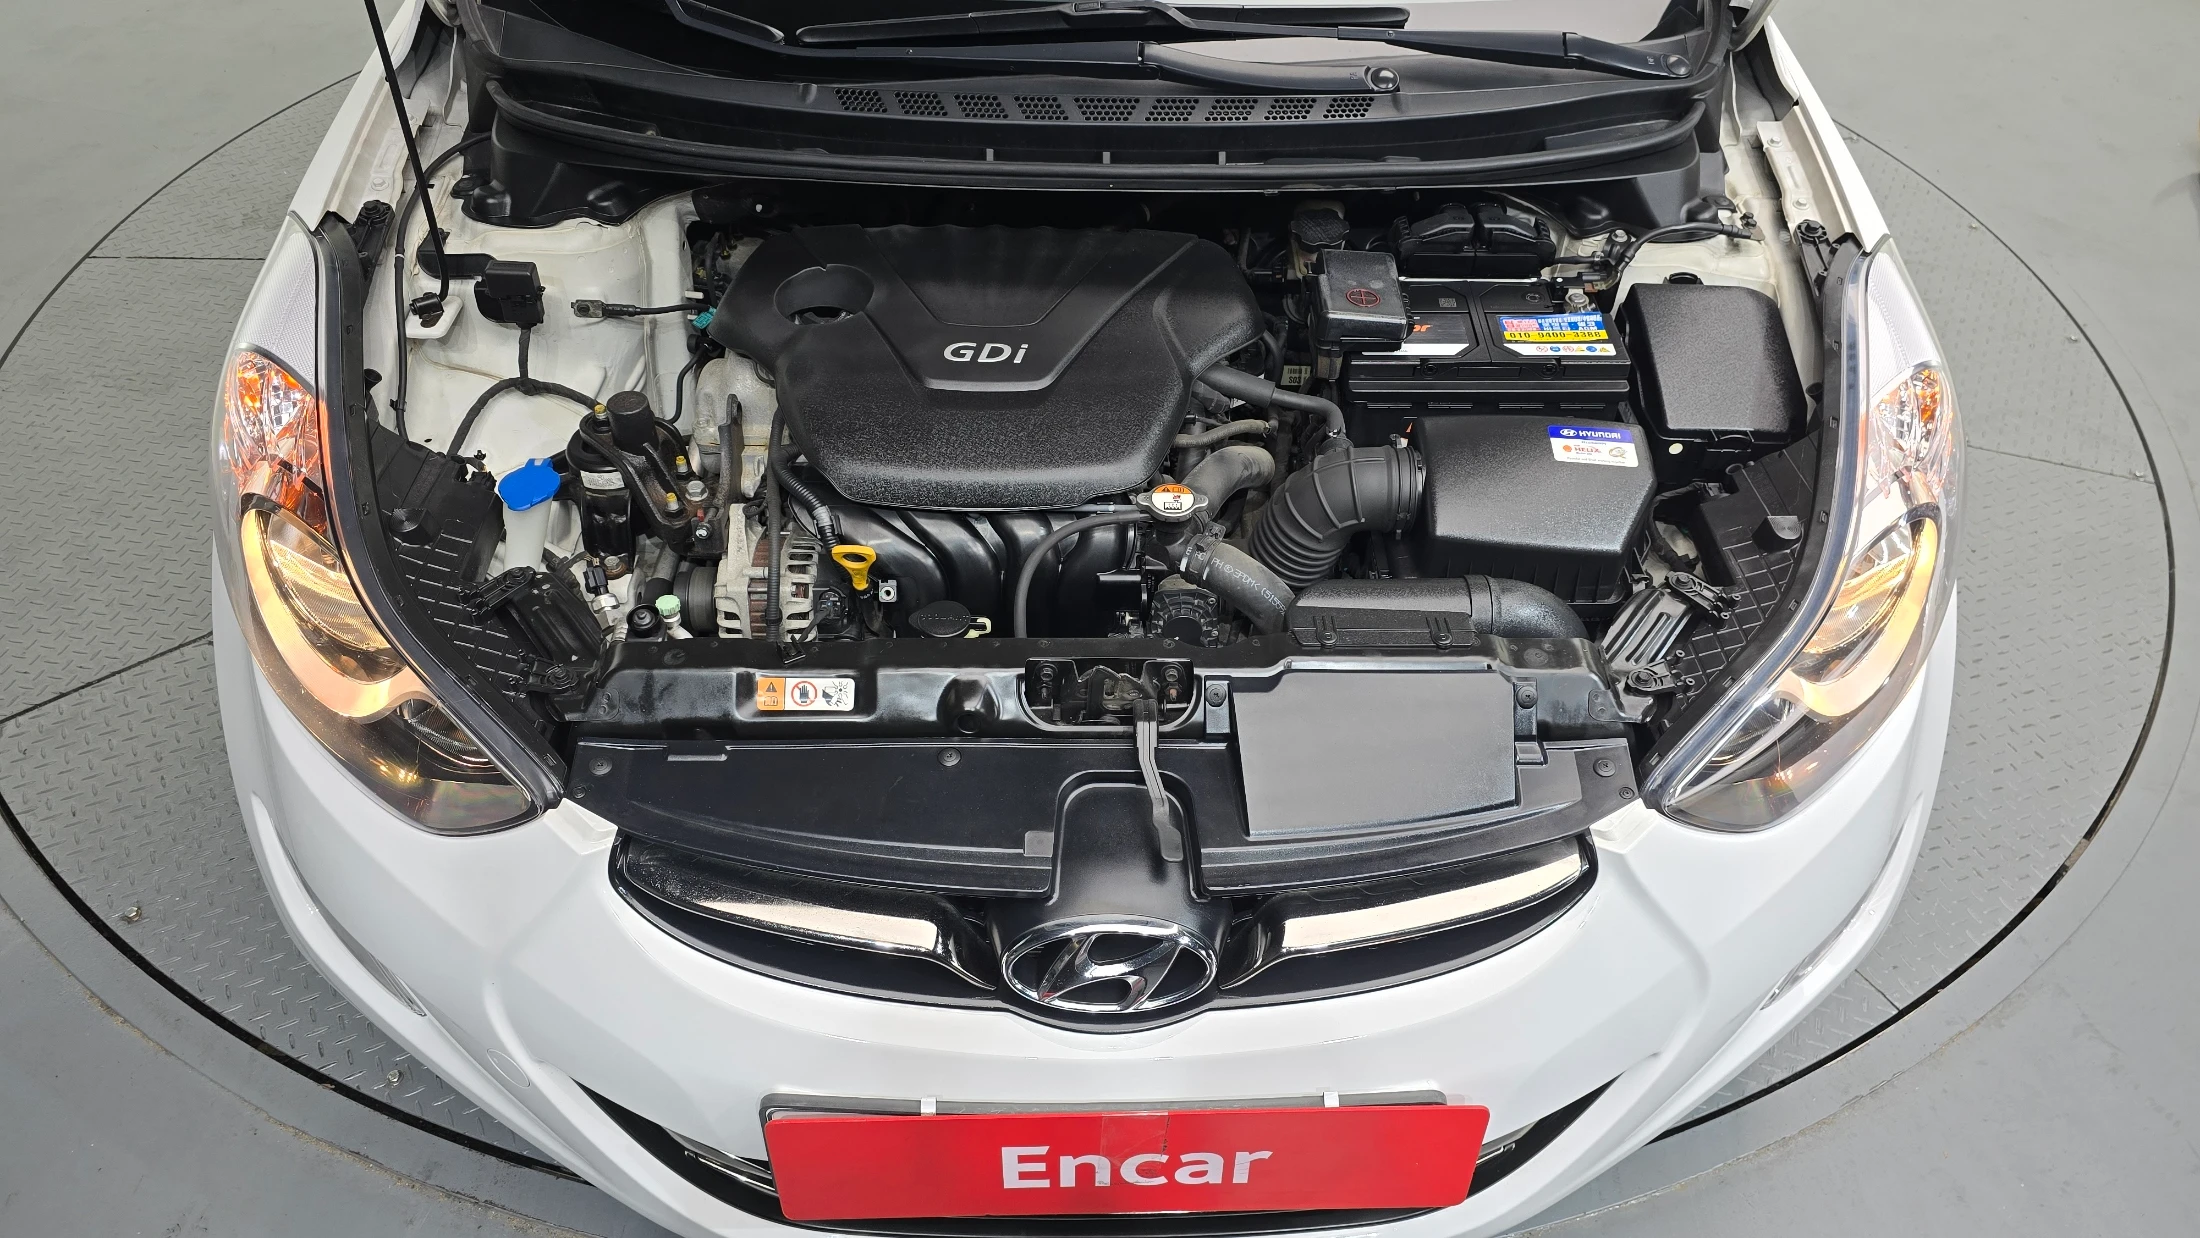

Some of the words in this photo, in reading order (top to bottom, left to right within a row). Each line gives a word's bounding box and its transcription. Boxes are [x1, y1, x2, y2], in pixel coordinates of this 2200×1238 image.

[943, 342, 1029, 364] GDi
[1578, 430, 1622, 440] HYUNDAI
[1001, 1145, 1274, 1189] Encar
